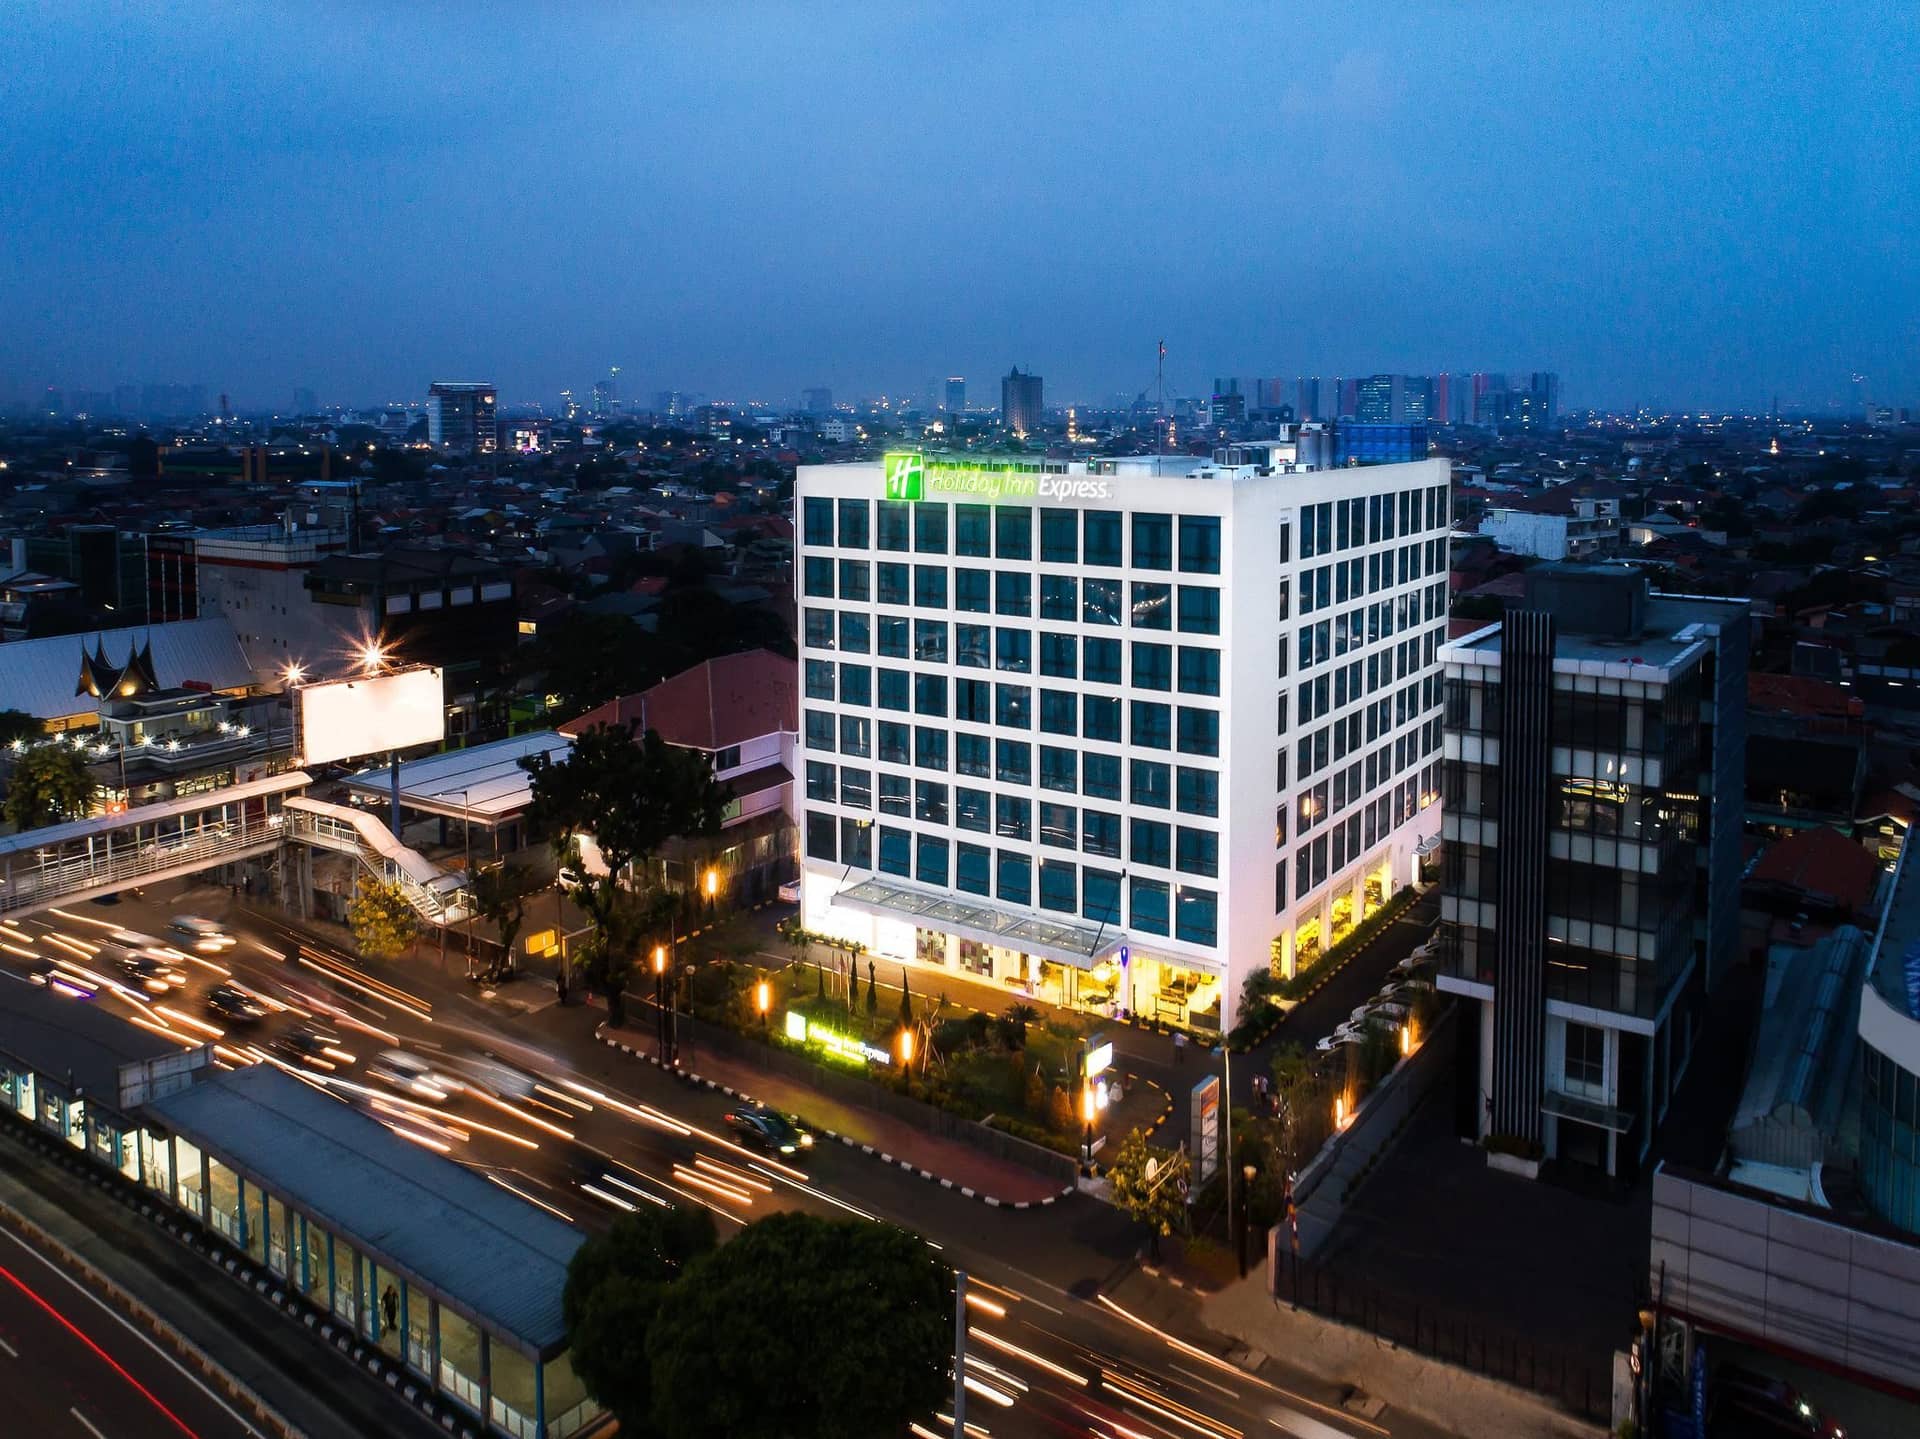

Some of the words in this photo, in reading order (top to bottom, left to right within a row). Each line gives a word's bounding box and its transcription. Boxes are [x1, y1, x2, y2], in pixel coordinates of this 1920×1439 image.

[929, 469, 1000, 498] Holiday
[1000, 470, 1035, 496] Inn
[1039, 472, 1108, 500] Express
